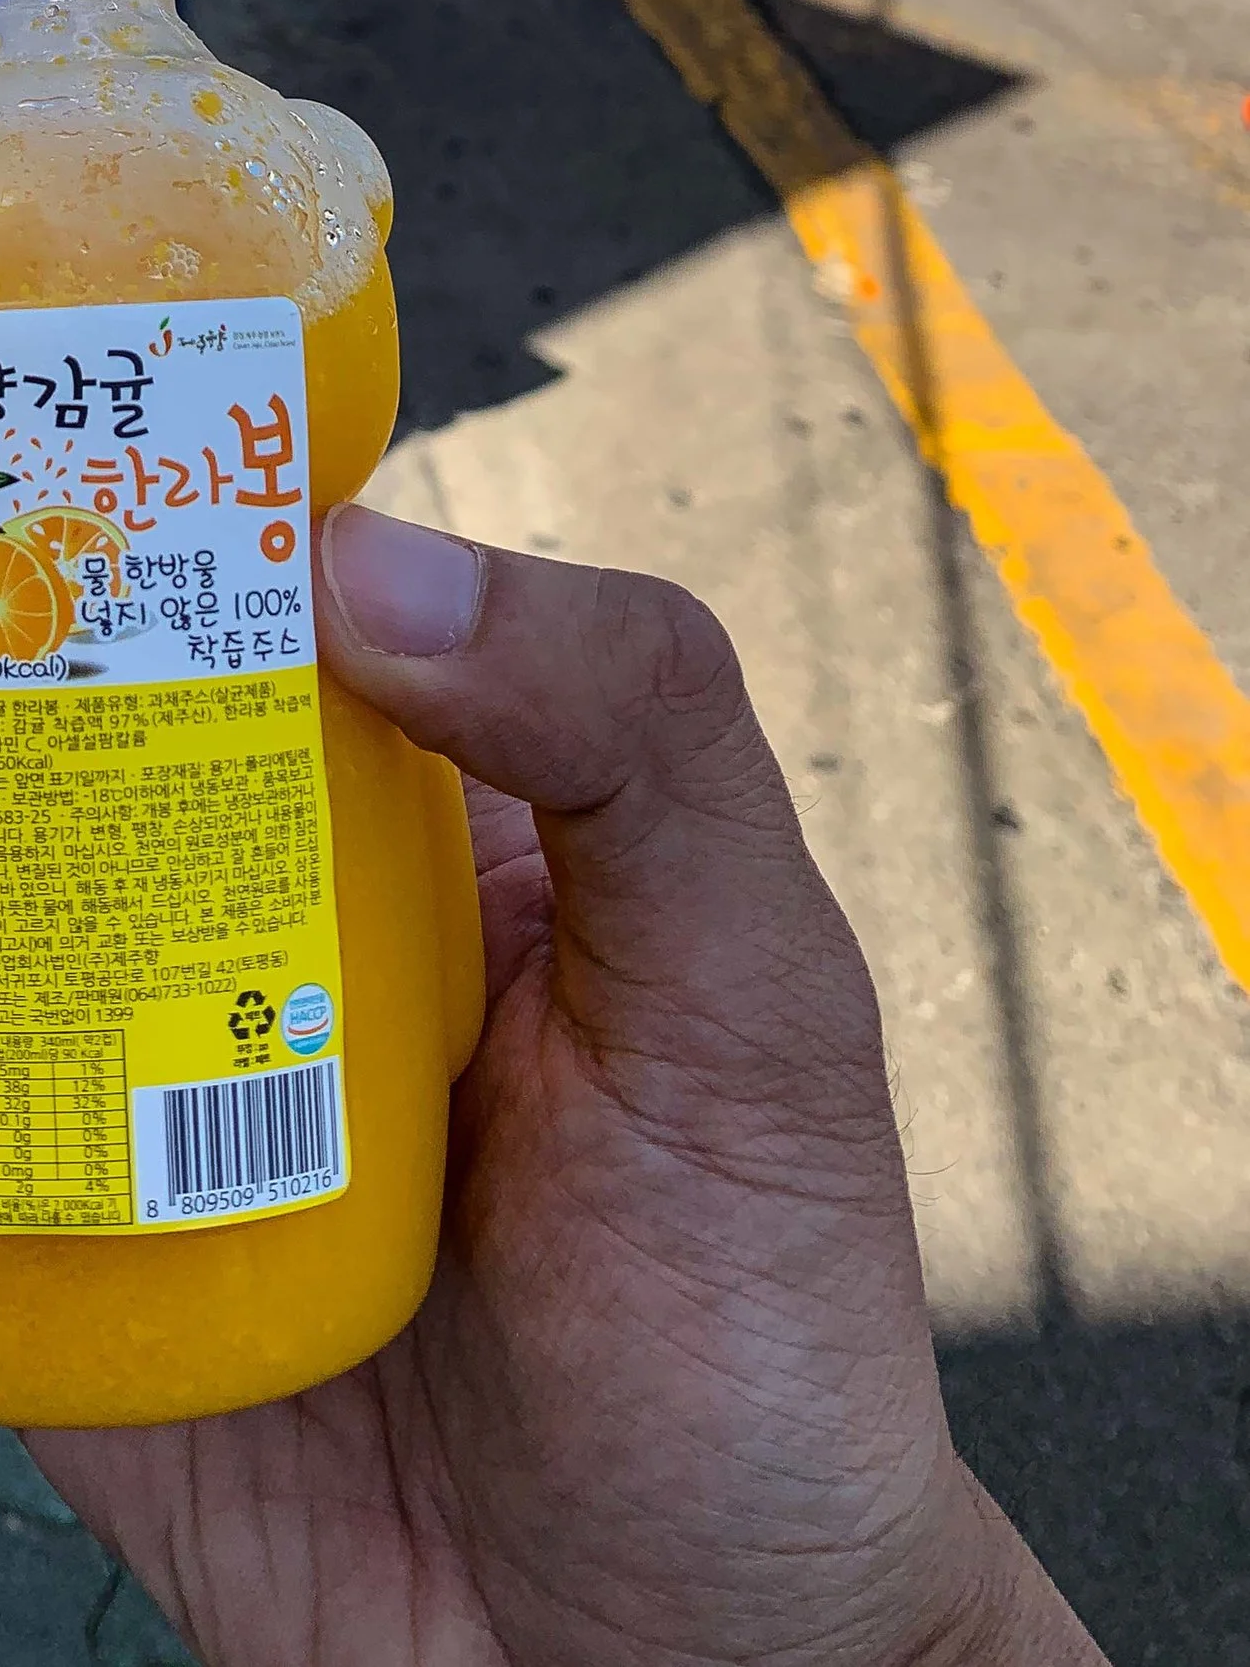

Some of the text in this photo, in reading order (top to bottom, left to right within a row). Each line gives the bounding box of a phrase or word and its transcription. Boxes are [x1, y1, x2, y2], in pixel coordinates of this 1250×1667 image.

[23, 349, 155, 439] 감귤
[80, 393, 303, 564] 한라봉
[82, 549, 218, 597] 물 한방울
[81, 585, 302, 638] 넣지 않은 100%
[12, 698, 59, 716] 한라봉
[13, 716, 45, 735] 감귤
[54, 714, 104, 733] 착즙액
[224, 701, 268, 722] 한라봉
[14, 771, 45, 790] 앞면
[49, 767, 126, 788] 표기일까지
[190, 774, 250, 797] 냉동보관
[34, 826, 81, 845] 용기가
[173, 808, 262, 836] 손상되었거나
[266, 799, 318, 823] 내용물이
[142, 800, 172, 819] 개봉
[177, 796, 222, 815] 후에는
[136, 836, 181, 858] 천연의
[265, 821, 291, 842] 의한
[294, 817, 318, 838] 침전
[16, 861, 62, 881] 변질된
[67, 860, 96, 880] 것이
[99, 856, 162, 878] 아니므로
[166, 850, 225, 873] 안심하고
[251, 840, 290, 863] 흔들어
[0, 881, 15, 898] 바
[19, 879, 67, 898] 있으니
[76, 877, 108, 897] 해동
[112, 877, 127, 894] 후
[134, 875, 148, 893] 재
[153, 867, 229, 892] 냉동시키지
[43, 897, 74, 916] 물에
[81, 894, 144, 916] 해동해서
[295, 869, 321, 891] 사용
[13, 916, 60, 935] 고르지
[67, 914, 98, 934] 않을
[105, 914, 122, 931] 수
[199, 906, 215, 924] 본
[221, 898, 264, 921] 제품은
[59, 934, 91, 952] 의거
[96, 932, 128, 950] 교환
[134, 930, 165, 948] 또는
[170, 921, 230, 945] 보상받을
[151, 963, 211, 982] 107번길
[29, 1007, 91, 1026] 국번없이
[95, 1006, 134, 1023] 1399
[146, 1199, 159, 1219] 8
[181, 1187, 255, 1215] 809509
[267, 1168, 332, 1202] 510216
